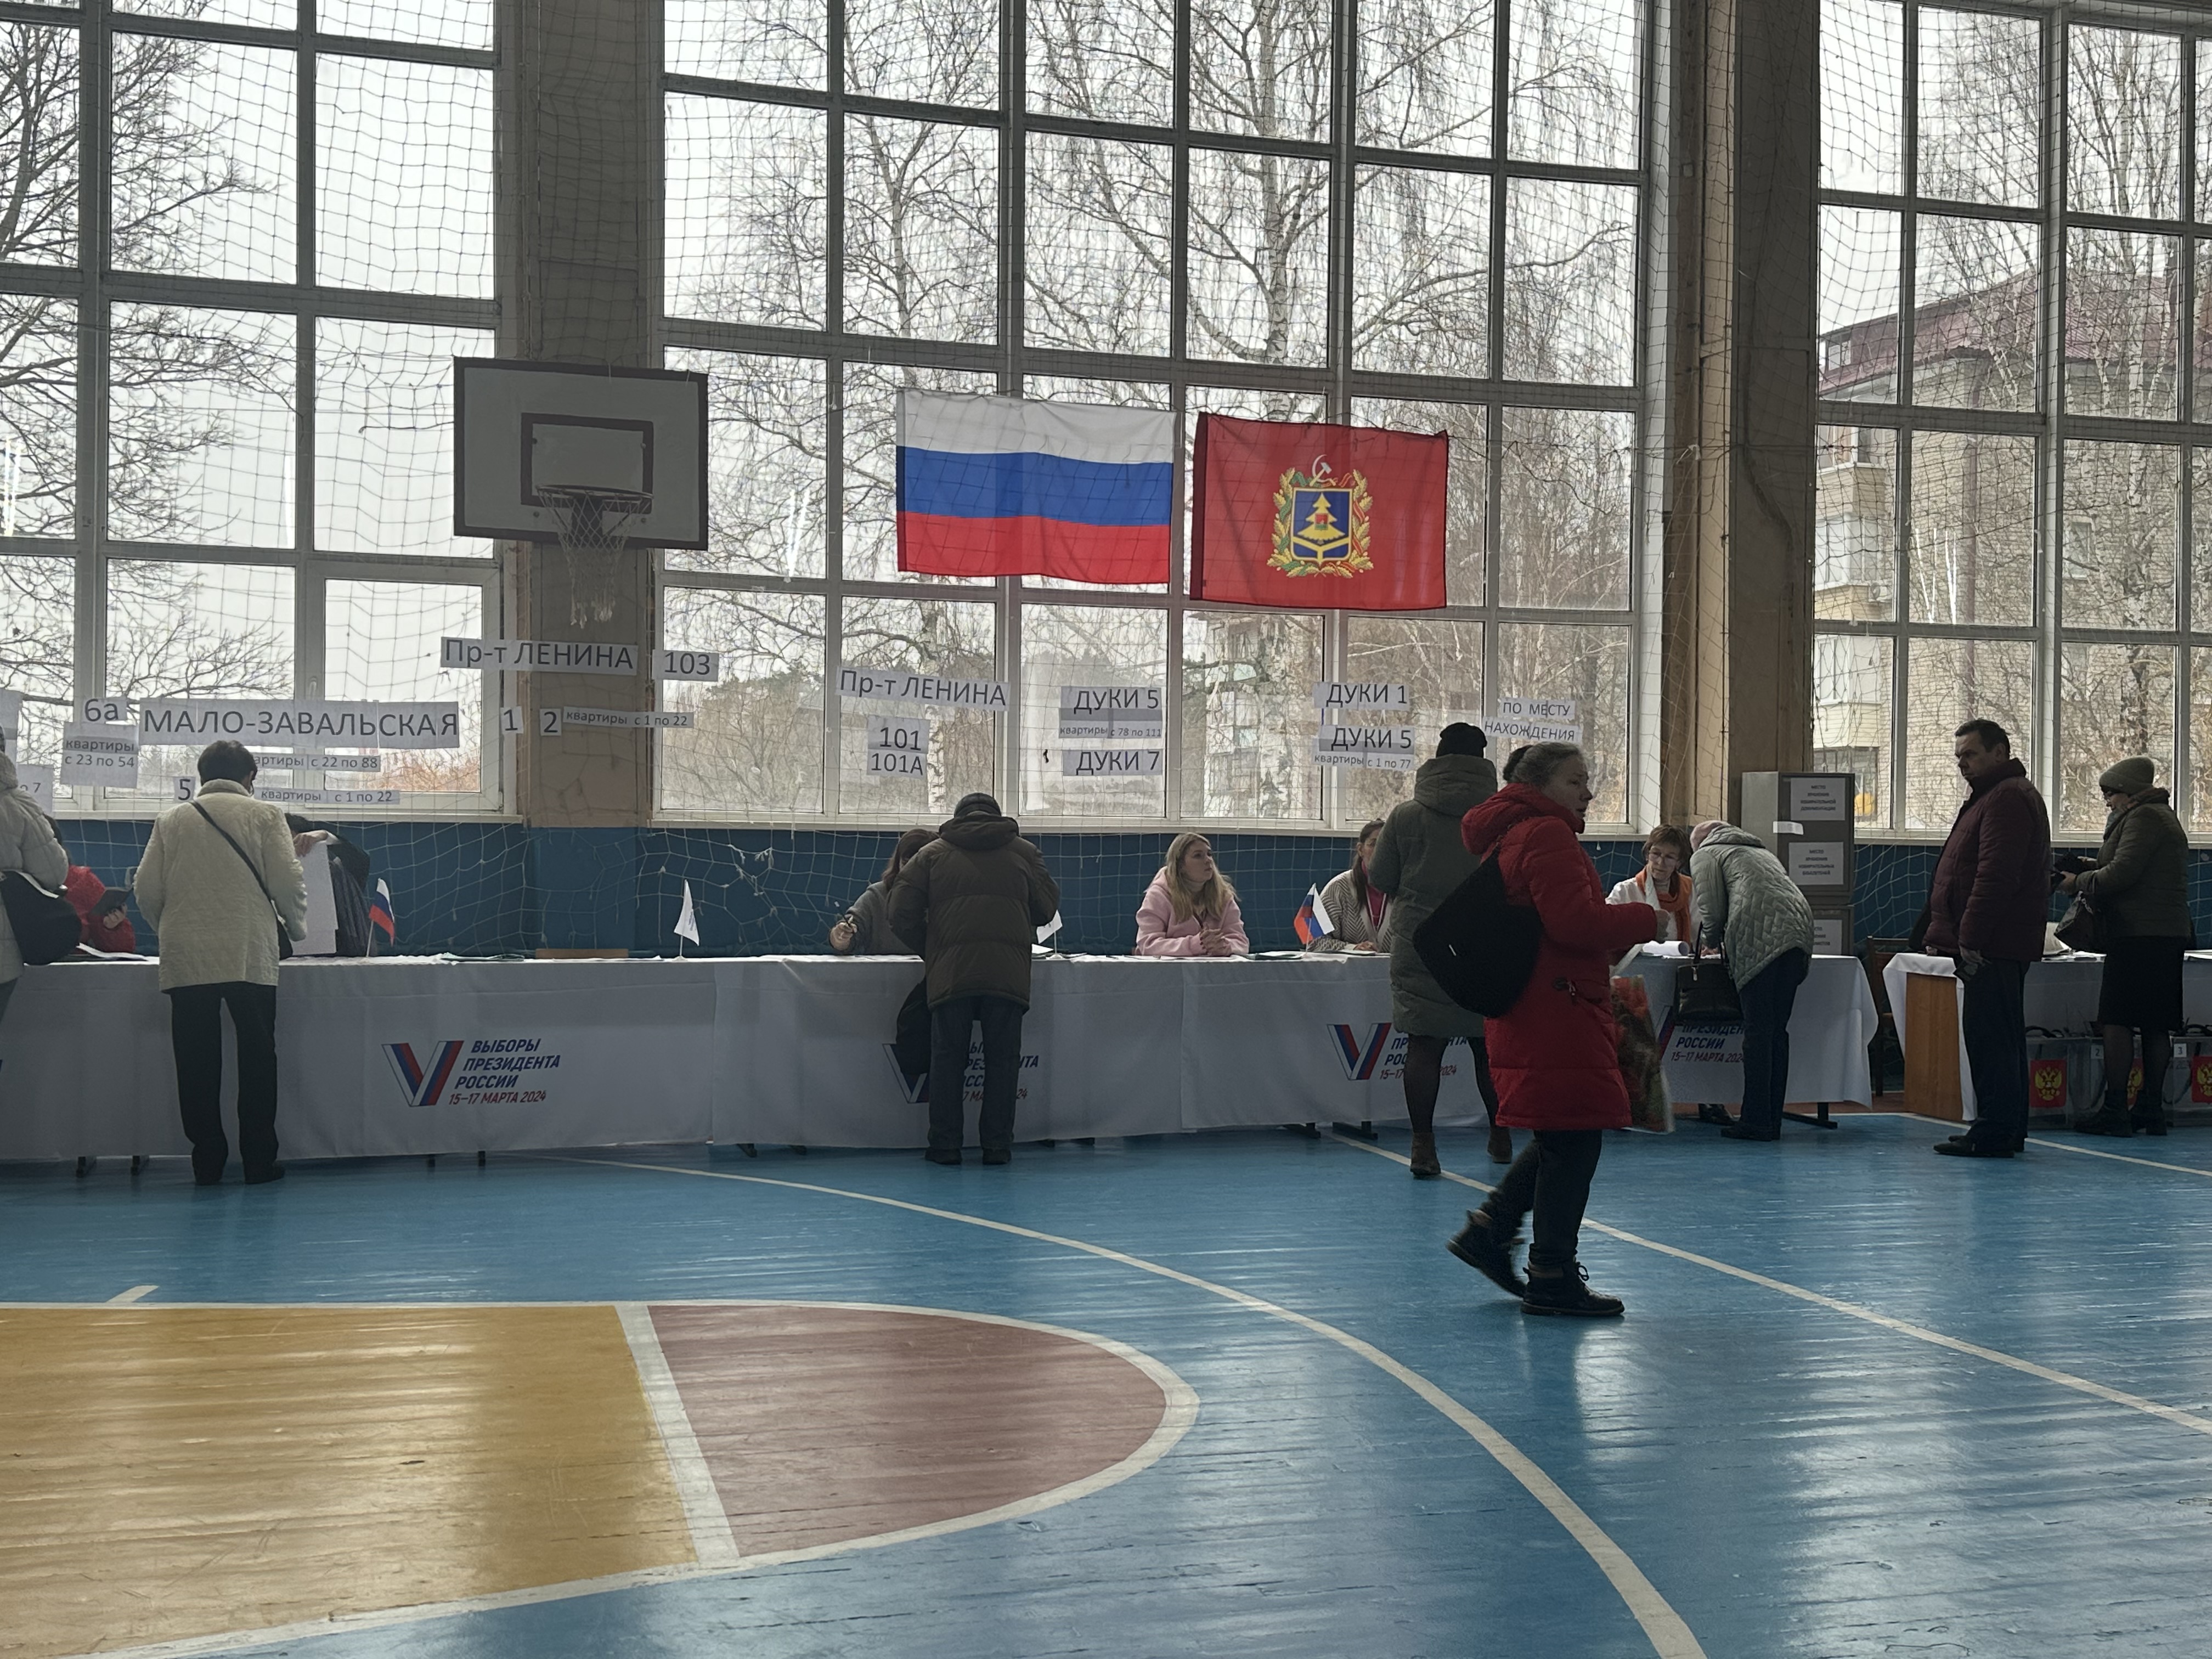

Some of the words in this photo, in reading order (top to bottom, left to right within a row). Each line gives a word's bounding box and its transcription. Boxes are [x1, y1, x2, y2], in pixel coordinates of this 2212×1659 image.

[445, 640, 507, 666] Пр-т
[514, 642, 633, 669] ЛЕНИНА
[664, 652, 710, 675] 103
[840, 670, 896, 697] Пр-т
[901, 677, 1006, 706] ЛЕНИНА
[1326, 684, 1388, 708] ДУКИ
[1398, 685, 1407, 703] 1
[84, 698, 118, 721] 6а
[1074, 689, 1138, 714] ДУКИ
[1147, 690, 1158, 708] 5
[1503, 703, 1521, 714] ПО
[1530, 704, 1570, 715] МЕСТУ
[145, 710, 457, 736] МАЛО-ЗАВАЛЬСКАЯ
[504, 709, 518, 731] 1
[544, 712, 557, 732] 2
[567, 710, 627, 724] квартиры
[645, 715, 650, 725] 1
[673, 716, 687, 726] 22
[879, 727, 921, 751] 101
[1060, 727, 1108, 735] квартиры
[1331, 728, 1391, 751] ДУКИ
[1400, 730, 1411, 748] 5
[1485, 721, 1574, 740] НАХОЖДЕНИЯ
[65, 741, 134, 752] квартиры
[76, 754, 92, 765] 23
[97, 758, 113, 766] по
[119, 757, 134, 767] 54
[255, 756, 303, 767] артиры
[322, 757, 337, 767] 22
[362, 758, 377, 768] 88
[871, 753, 923, 775] 101А
[1076, 752, 1138, 775] ДУКИ
[1148, 751, 1159, 770] 7
[1314, 755, 1364, 765] квартиры
[1376, 758, 1380, 767] 1
[1400, 759, 1410, 768] 77
[178, 779, 191, 801] 5
[261, 791, 321, 801] квартиры
[347, 792, 352, 802] 1
[377, 792, 392, 802] 22
[471, 1039, 541, 1053] ВЫБОРЫ
[1676, 1037, 1725, 1049] РОССИИ
[463, 1055, 561, 1071] ПРЕЗИДЕНТА
[1695, 1052, 1725, 1062] МАРТА
[454, 1075, 518, 1089] РОССИИ
[481, 1092, 518, 1104] МАРТА
[521, 1090, 546, 1103] 2024
